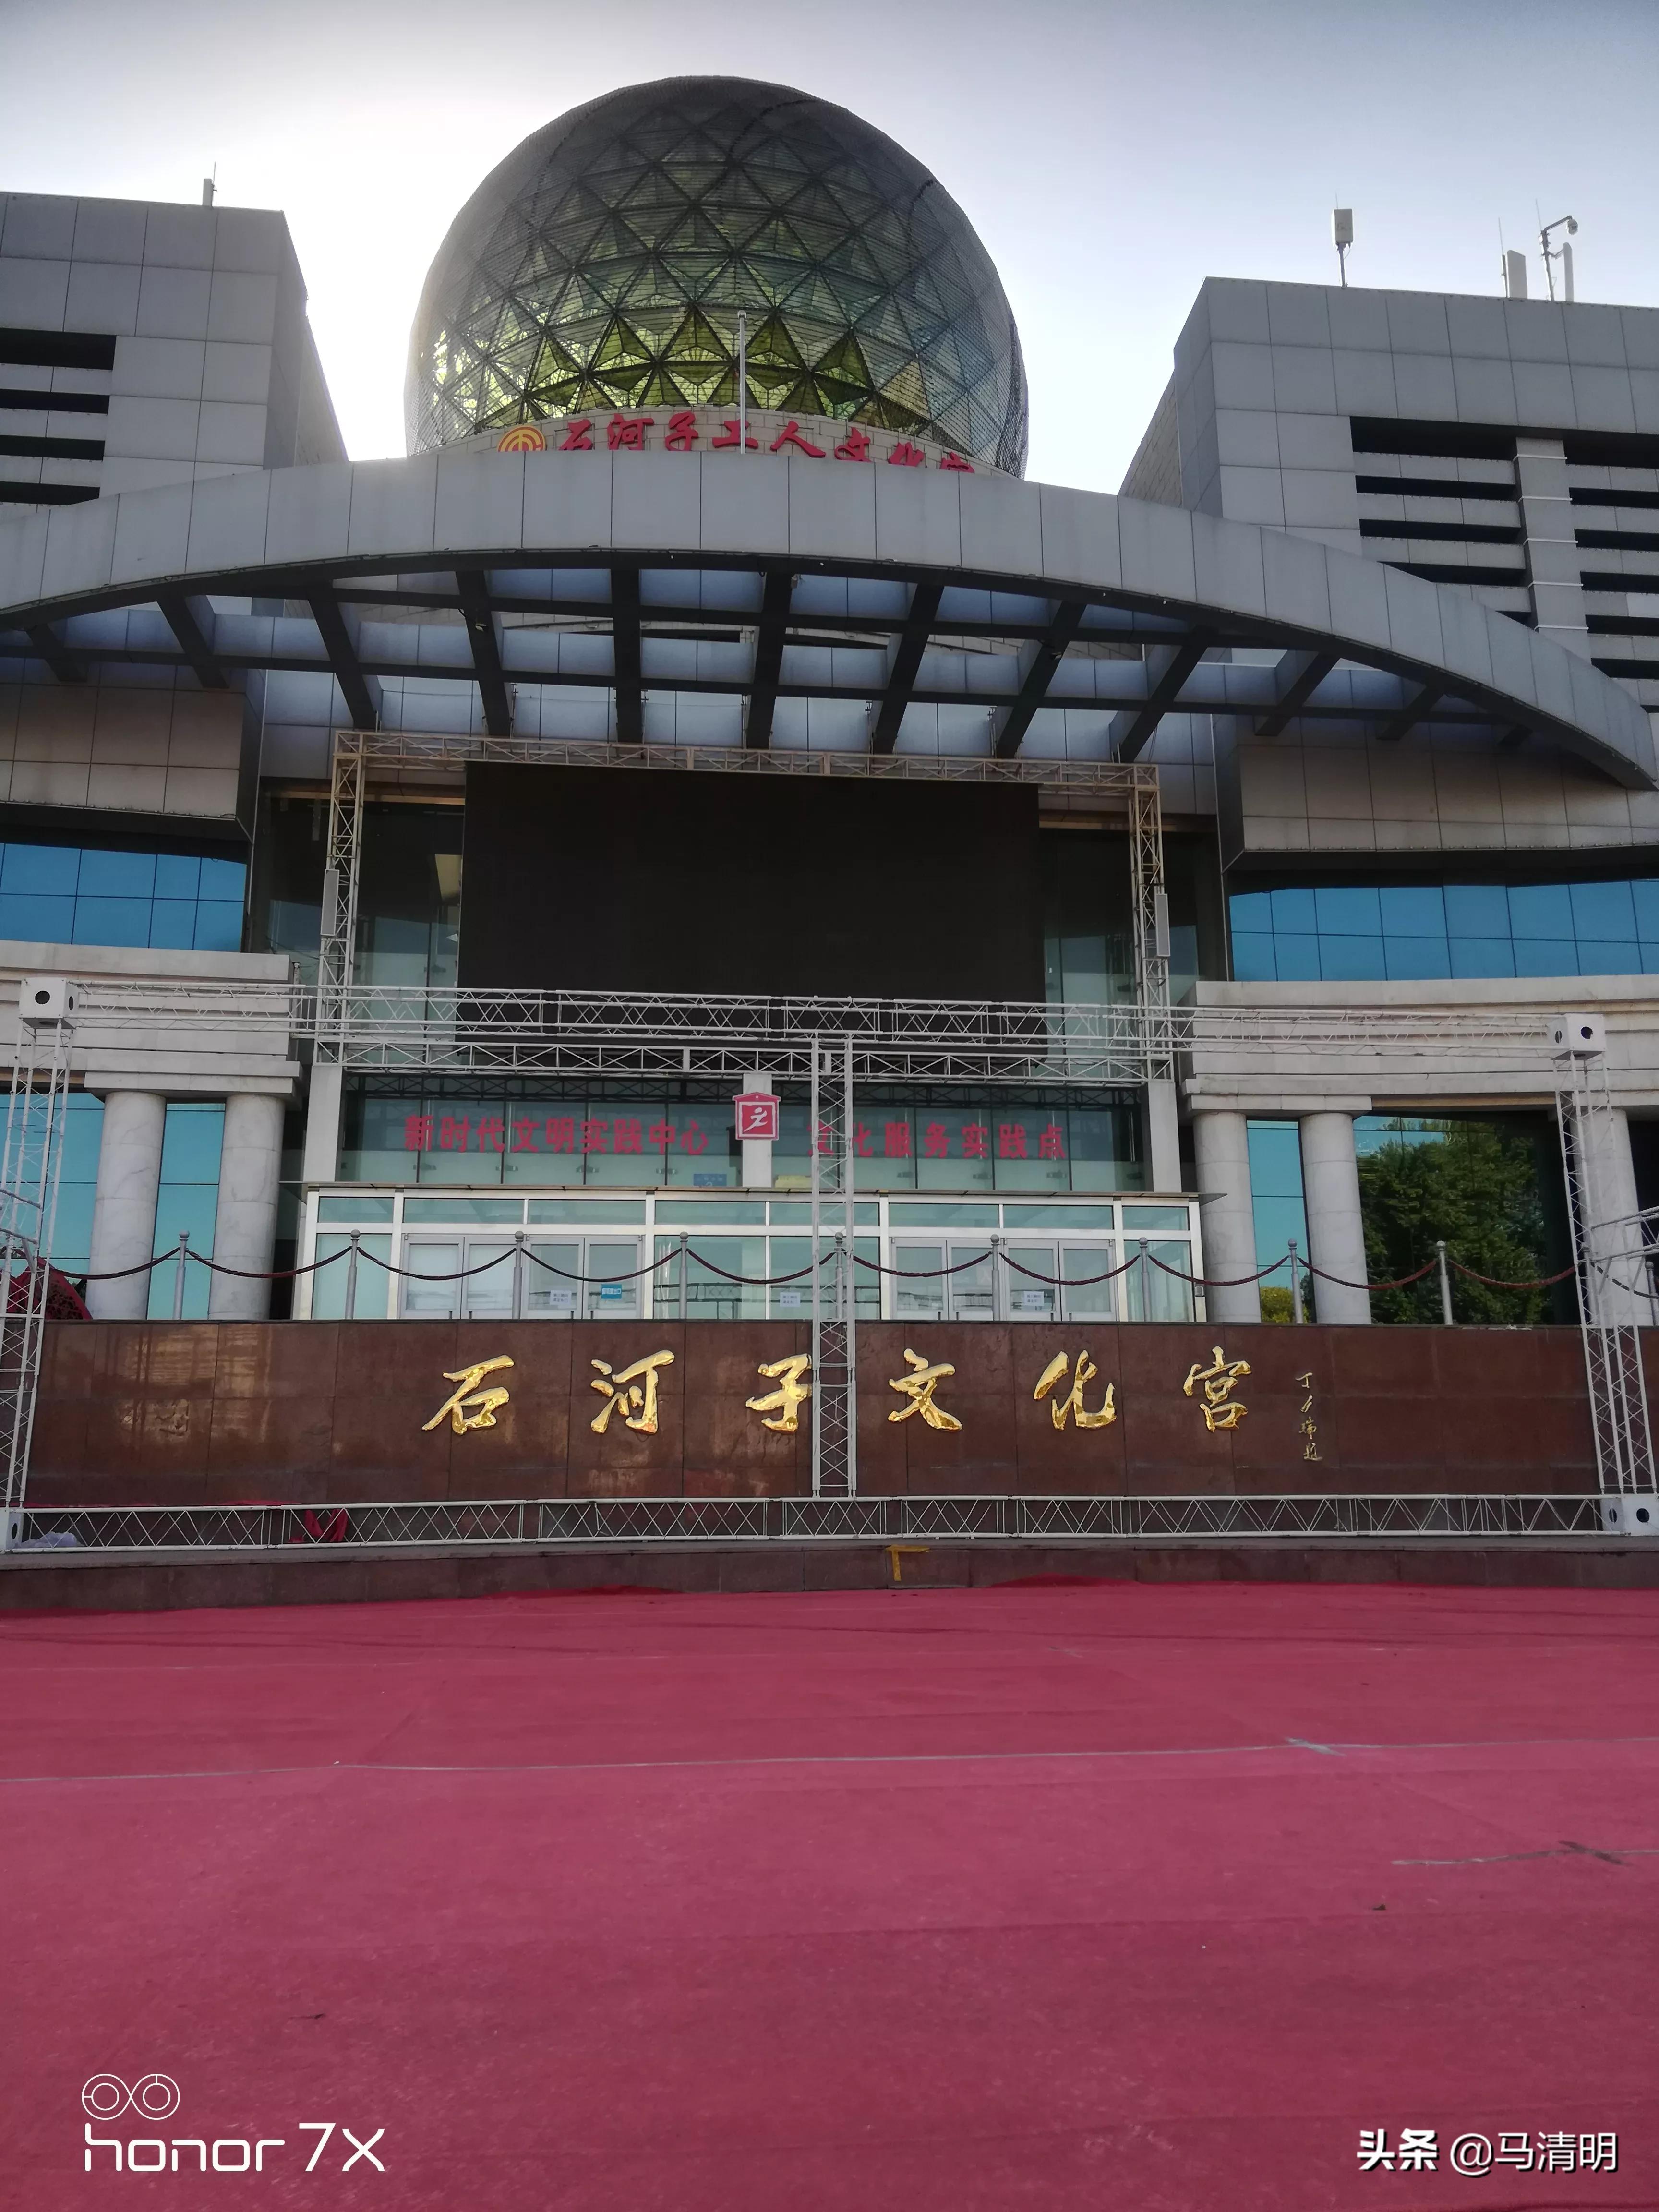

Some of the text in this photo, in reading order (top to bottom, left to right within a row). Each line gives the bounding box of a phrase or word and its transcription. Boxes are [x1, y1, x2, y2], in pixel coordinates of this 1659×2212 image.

[405, 1115, 708, 1154] 新时代文明实践中心
[421, 1346, 1251, 1435] 石河子文化宫
